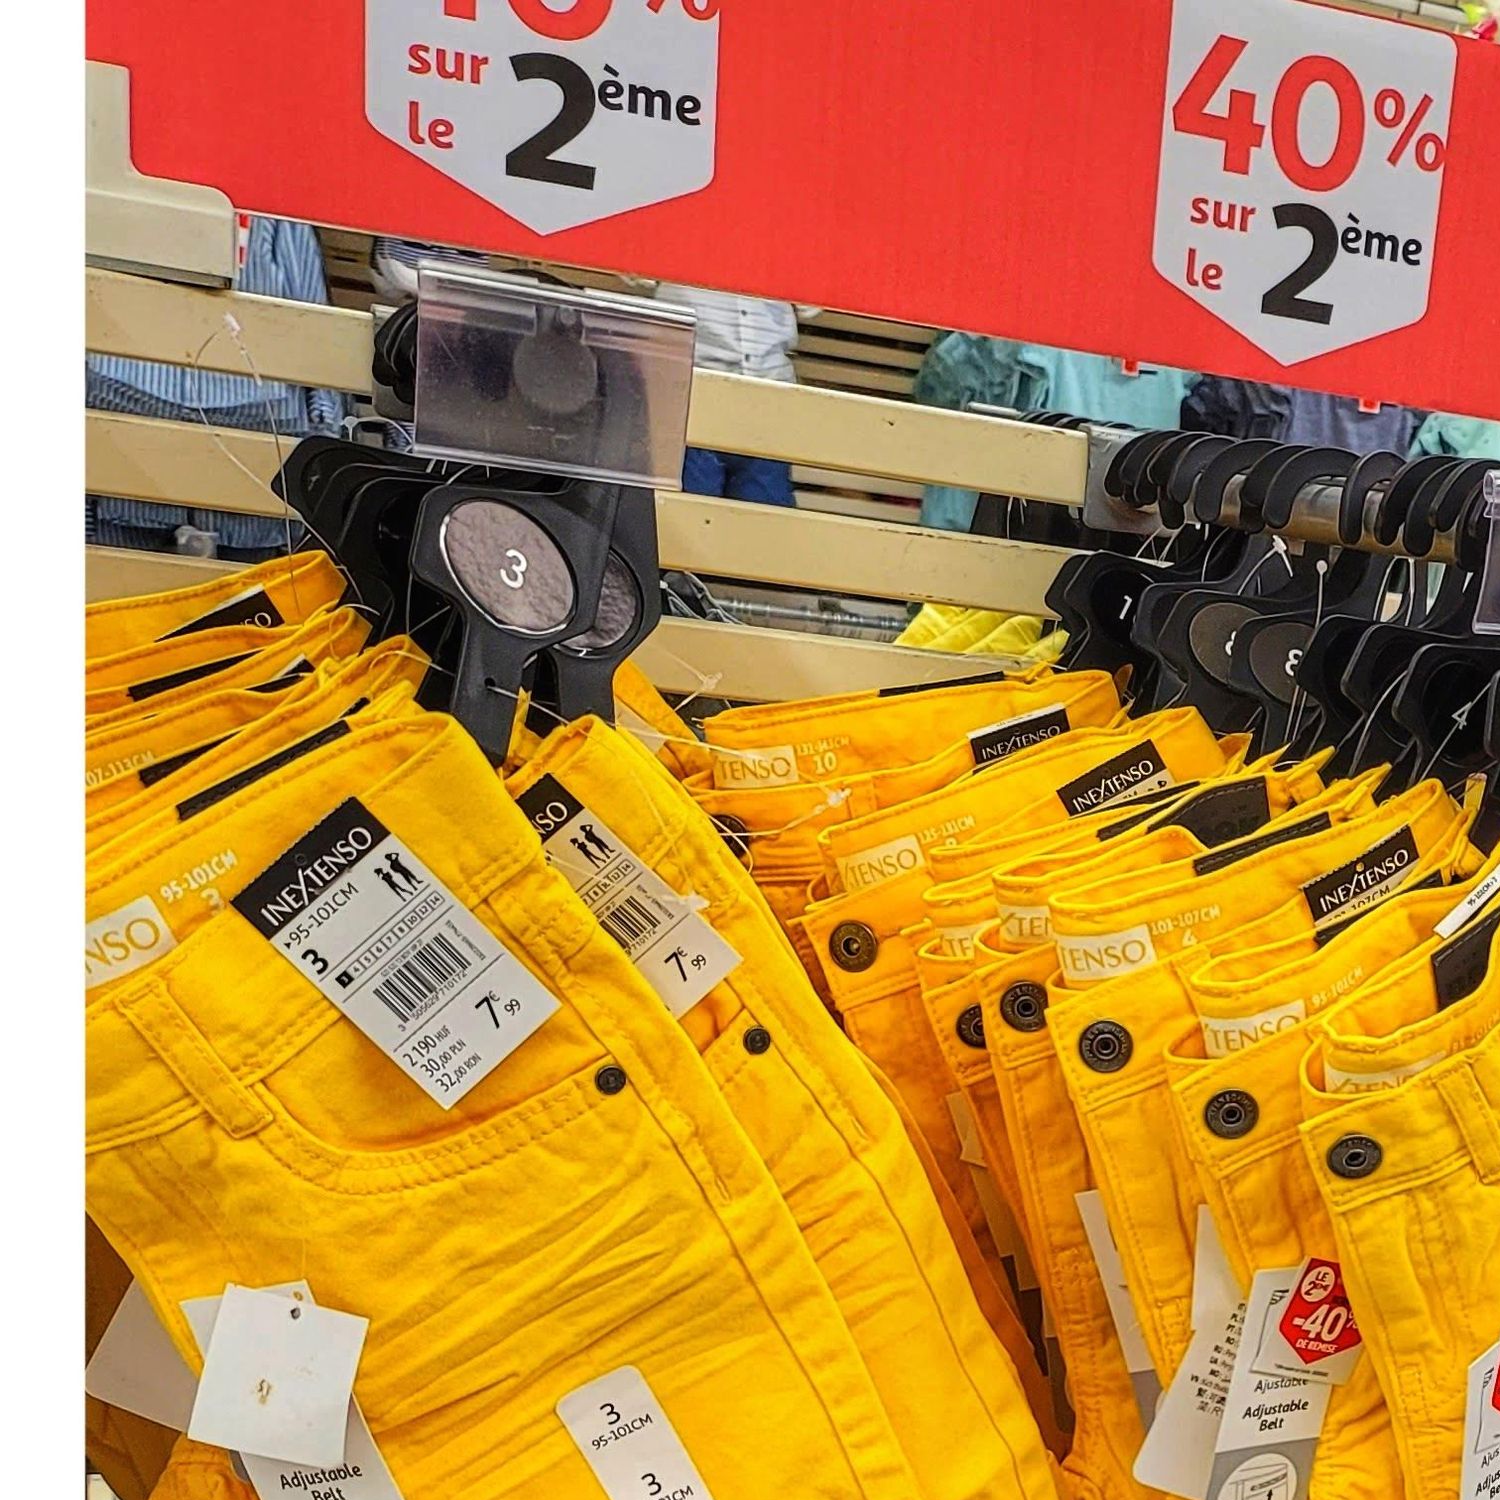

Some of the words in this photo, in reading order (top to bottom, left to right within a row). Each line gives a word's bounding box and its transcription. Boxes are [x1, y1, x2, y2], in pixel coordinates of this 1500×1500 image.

[407, 43, 489, 85] sur
[408, 100, 454, 149] le
[1173, 34, 1446, 192] 40%
[1190, 197, 1257, 233] sur
[1186, 247, 1223, 290] le
[500, 548, 528, 589] 3
[1451, 702, 1473, 730] 4
[981, 724, 1061, 760] INEXTENSO
[813, 753, 838, 774] 10
[1072, 759, 1155, 813] INEXTENSO
[160, 848, 239, 904] 95-101CM
[259, 826, 373, 927] INEXTENSO
[1319, 848, 1409, 913] INEXTENSO
[288, 881, 360, 947] 95-101CM
[1182, 930, 1198, 947] 4
[301, 948, 329, 976] 3
[599, 1402, 621, 1425] 3
[1243, 1399, 1309, 1420] Adjustable
[1259, 1417, 1285, 1433] Belt
[591, 1413, 653, 1451] 95-101CM
[279, 1462, 363, 1491] Adjustable
[640, 1472, 662, 1496] 3
